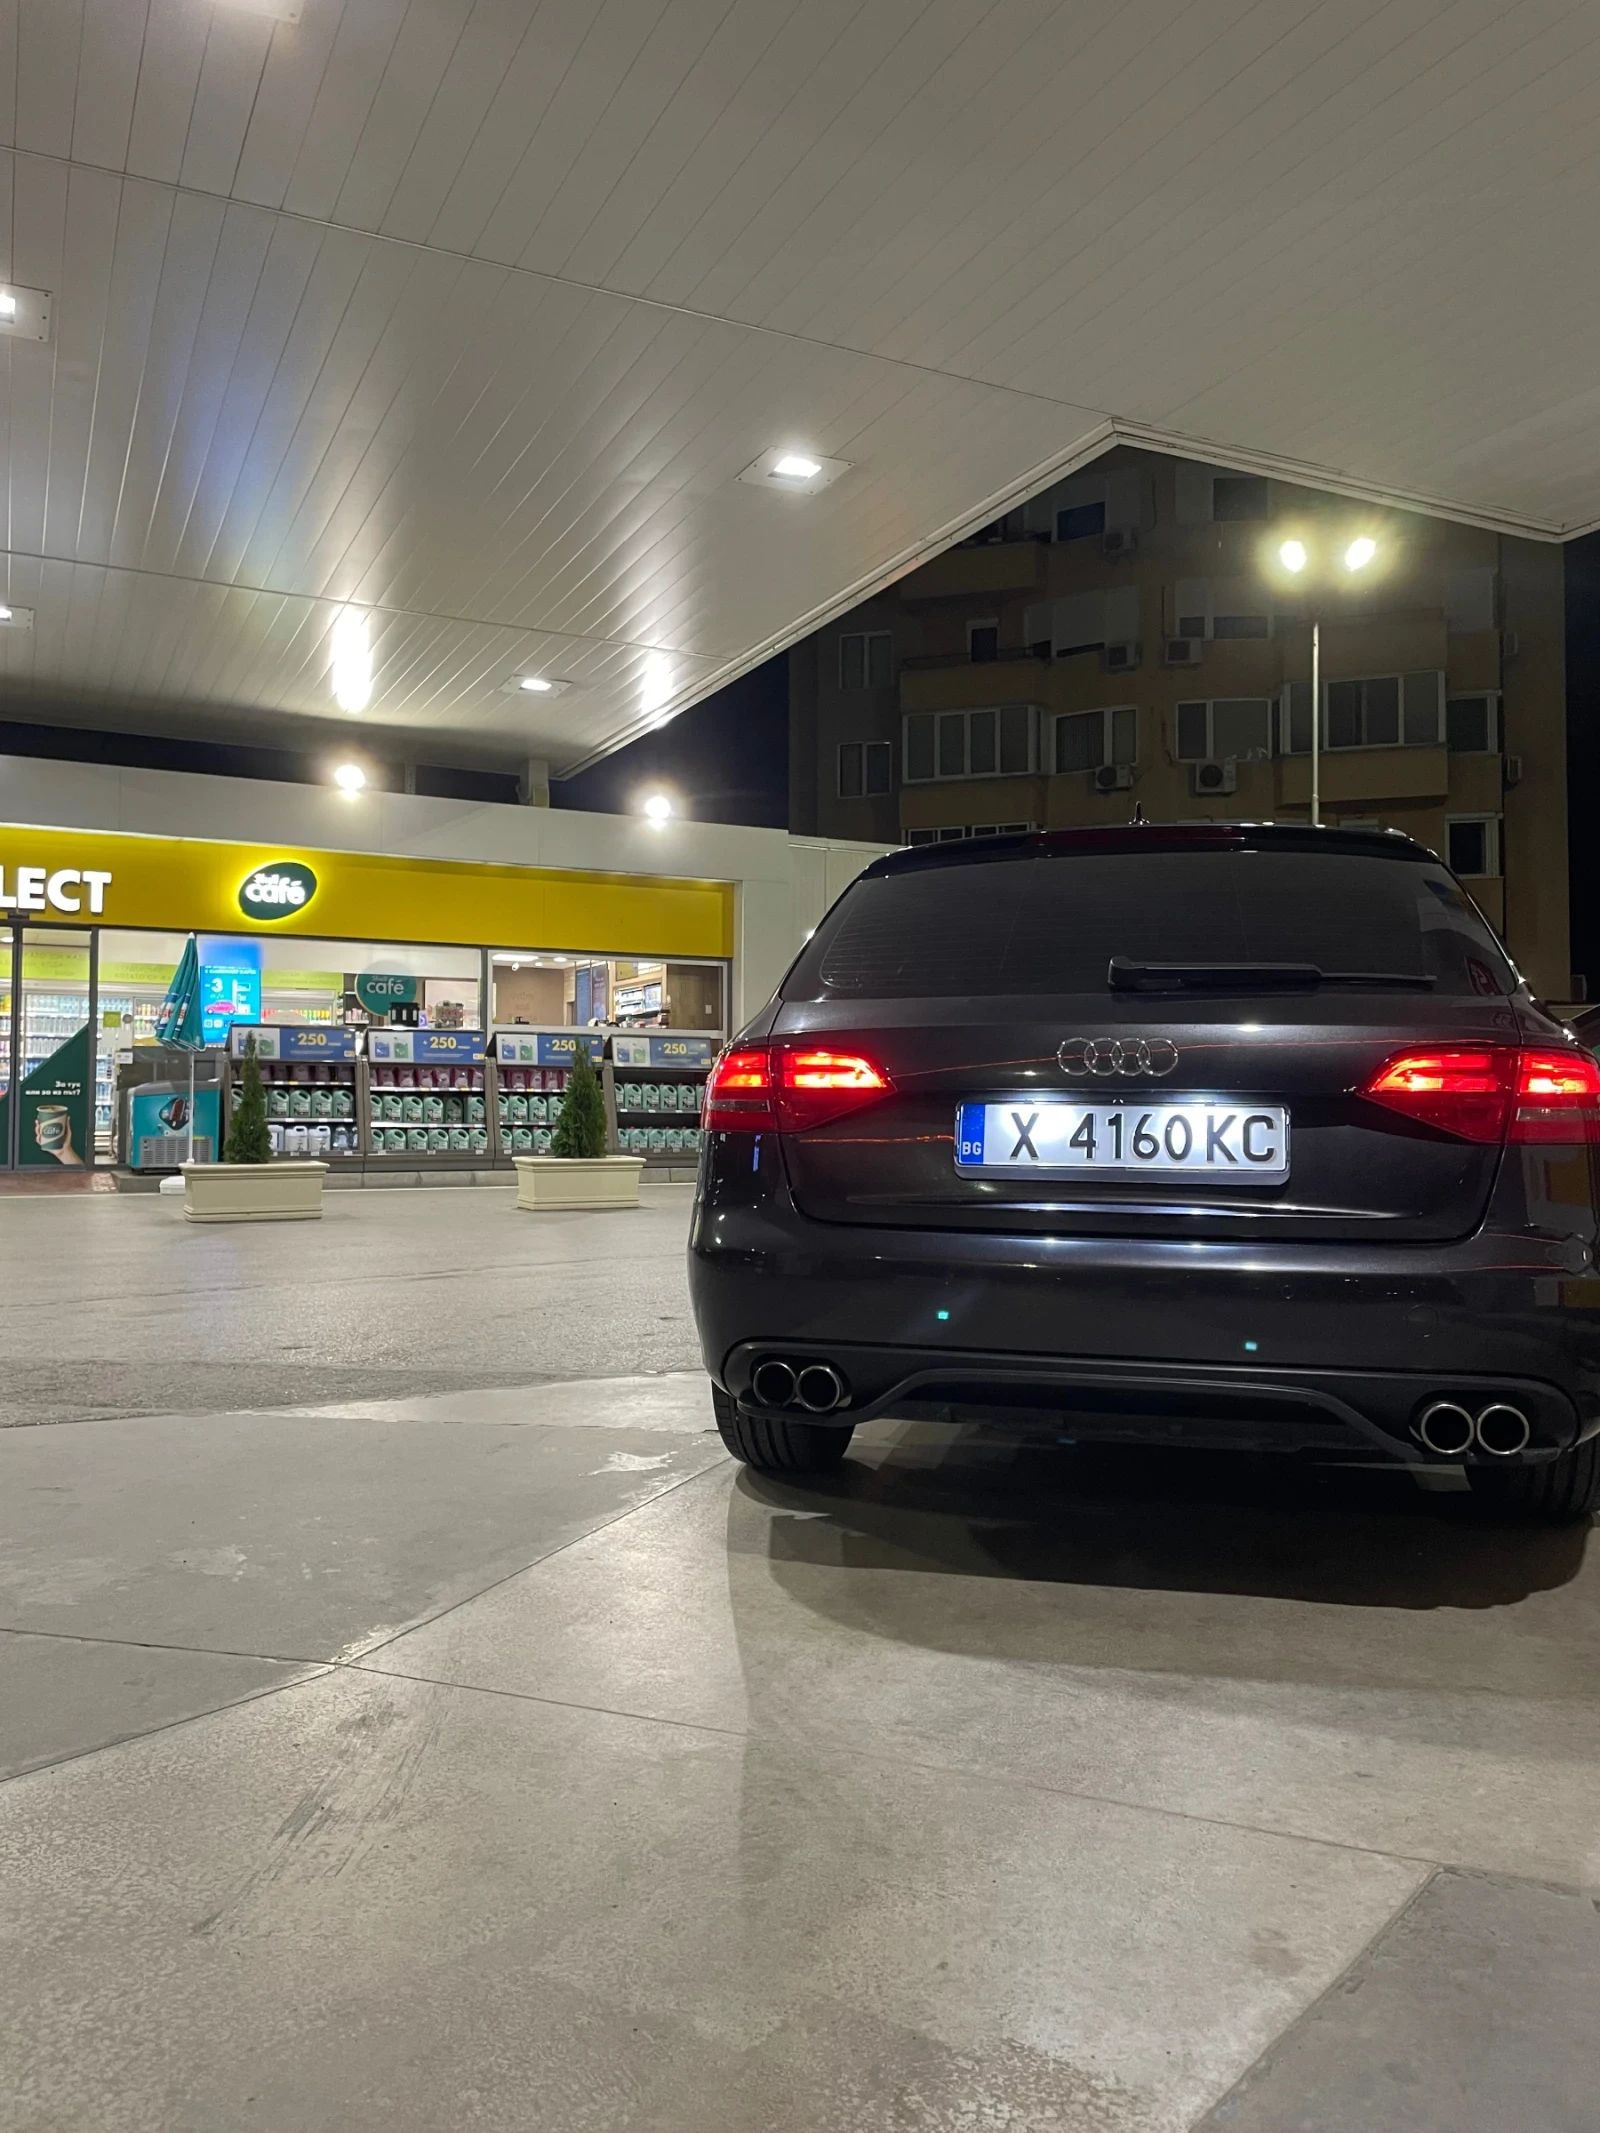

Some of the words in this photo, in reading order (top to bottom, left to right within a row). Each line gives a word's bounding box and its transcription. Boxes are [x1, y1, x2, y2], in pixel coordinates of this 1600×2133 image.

[245, 876, 306, 905] café
[366, 977, 405, 995] café
[297, 1032, 327, 1046] 250
[430, 1036, 457, 1049] 250
[551, 1039, 577, 1051] 250
[663, 1042, 687, 1055] 250
[1010, 1112, 1039, 1161] X
[1069, 1113, 1194, 1162] 4160
[1206, 1114, 1278, 1164] KC
[961, 1141, 982, 1156] BG
